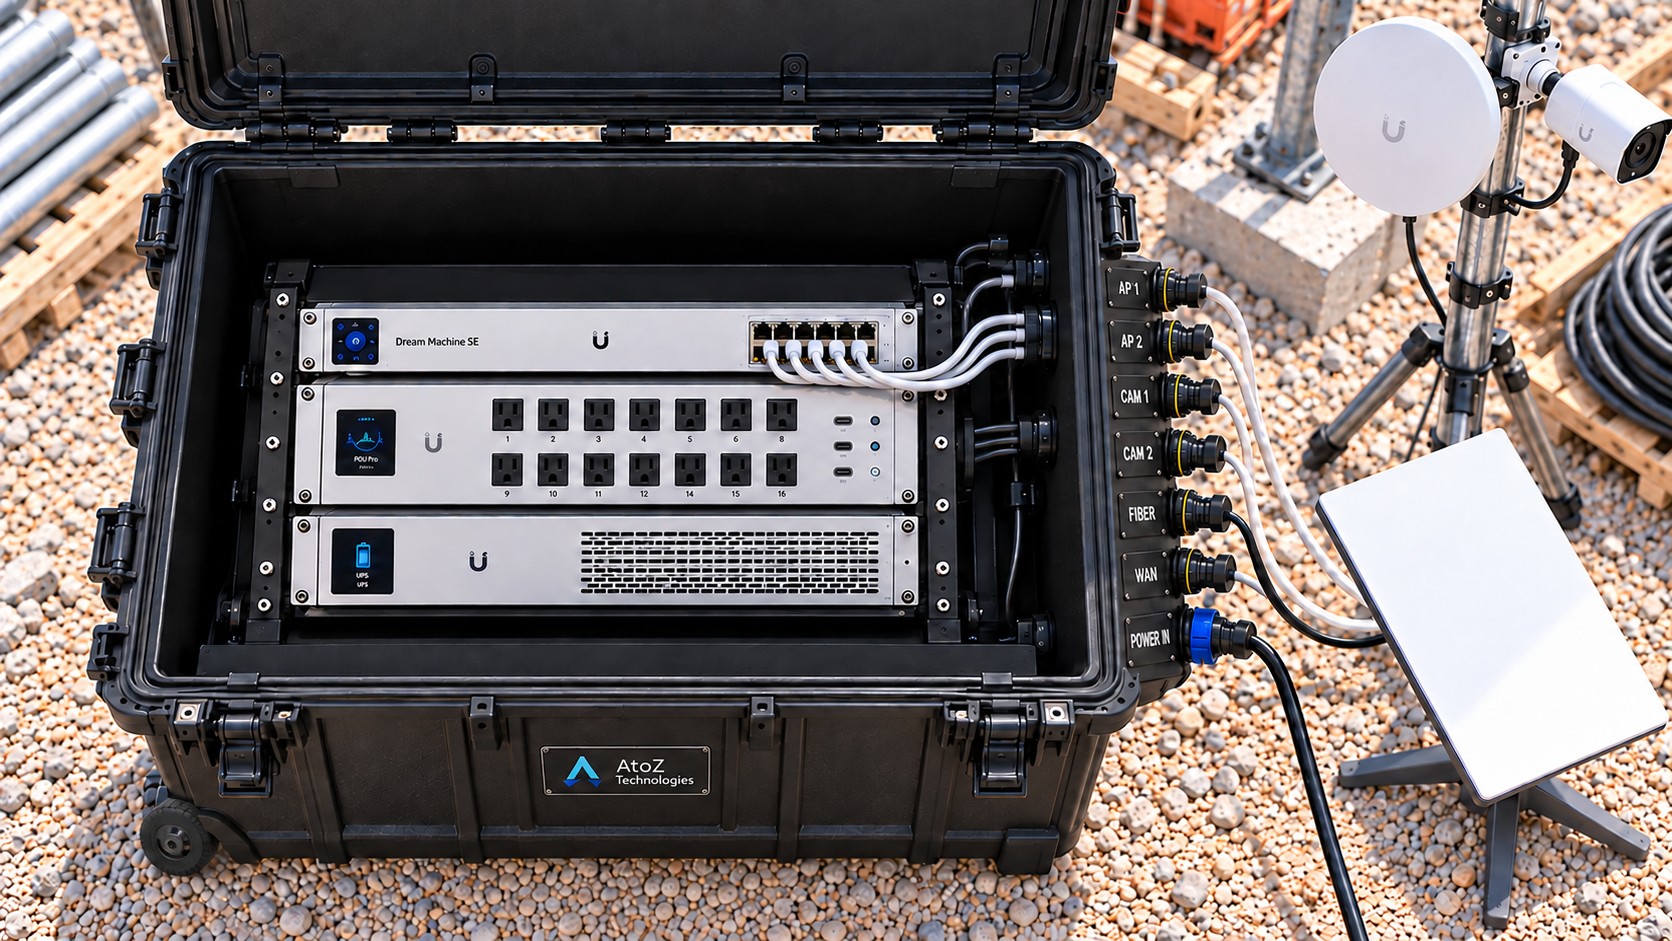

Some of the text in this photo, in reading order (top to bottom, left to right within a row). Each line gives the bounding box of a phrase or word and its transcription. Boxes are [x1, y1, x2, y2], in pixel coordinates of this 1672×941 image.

[1119, 281, 1139, 296] AP 1
[395, 337, 479, 347] Dream Machine SE
[1121, 333, 1143, 350] AP 2
[1120, 389, 1150, 404] CAM 1
[506, 435, 510, 443] 1
[550, 435, 556, 443] 2
[595, 435, 602, 443] 3
[641, 435, 647, 443] 4
[687, 435, 693, 443] 5
[733, 435, 739, 443] 6
[779, 435, 785, 443] 8
[1123, 444, 1154, 461] CAM 2
[504, 490, 510, 498] 9
[549, 490, 558, 498] 10
[595, 490, 602, 498] 11
[640, 490, 649, 498] 12
[685, 490, 694, 498] 14
[731, 490, 741, 498] 15
[778, 490, 787, 498] 16
[1128, 505, 1157, 522] FIBER
[1134, 566, 1158, 583] WAN
[1130, 628, 1171, 649] POWER IN
[616, 758, 665, 773] AtoZ
[615, 775, 694, 787] Technologies
